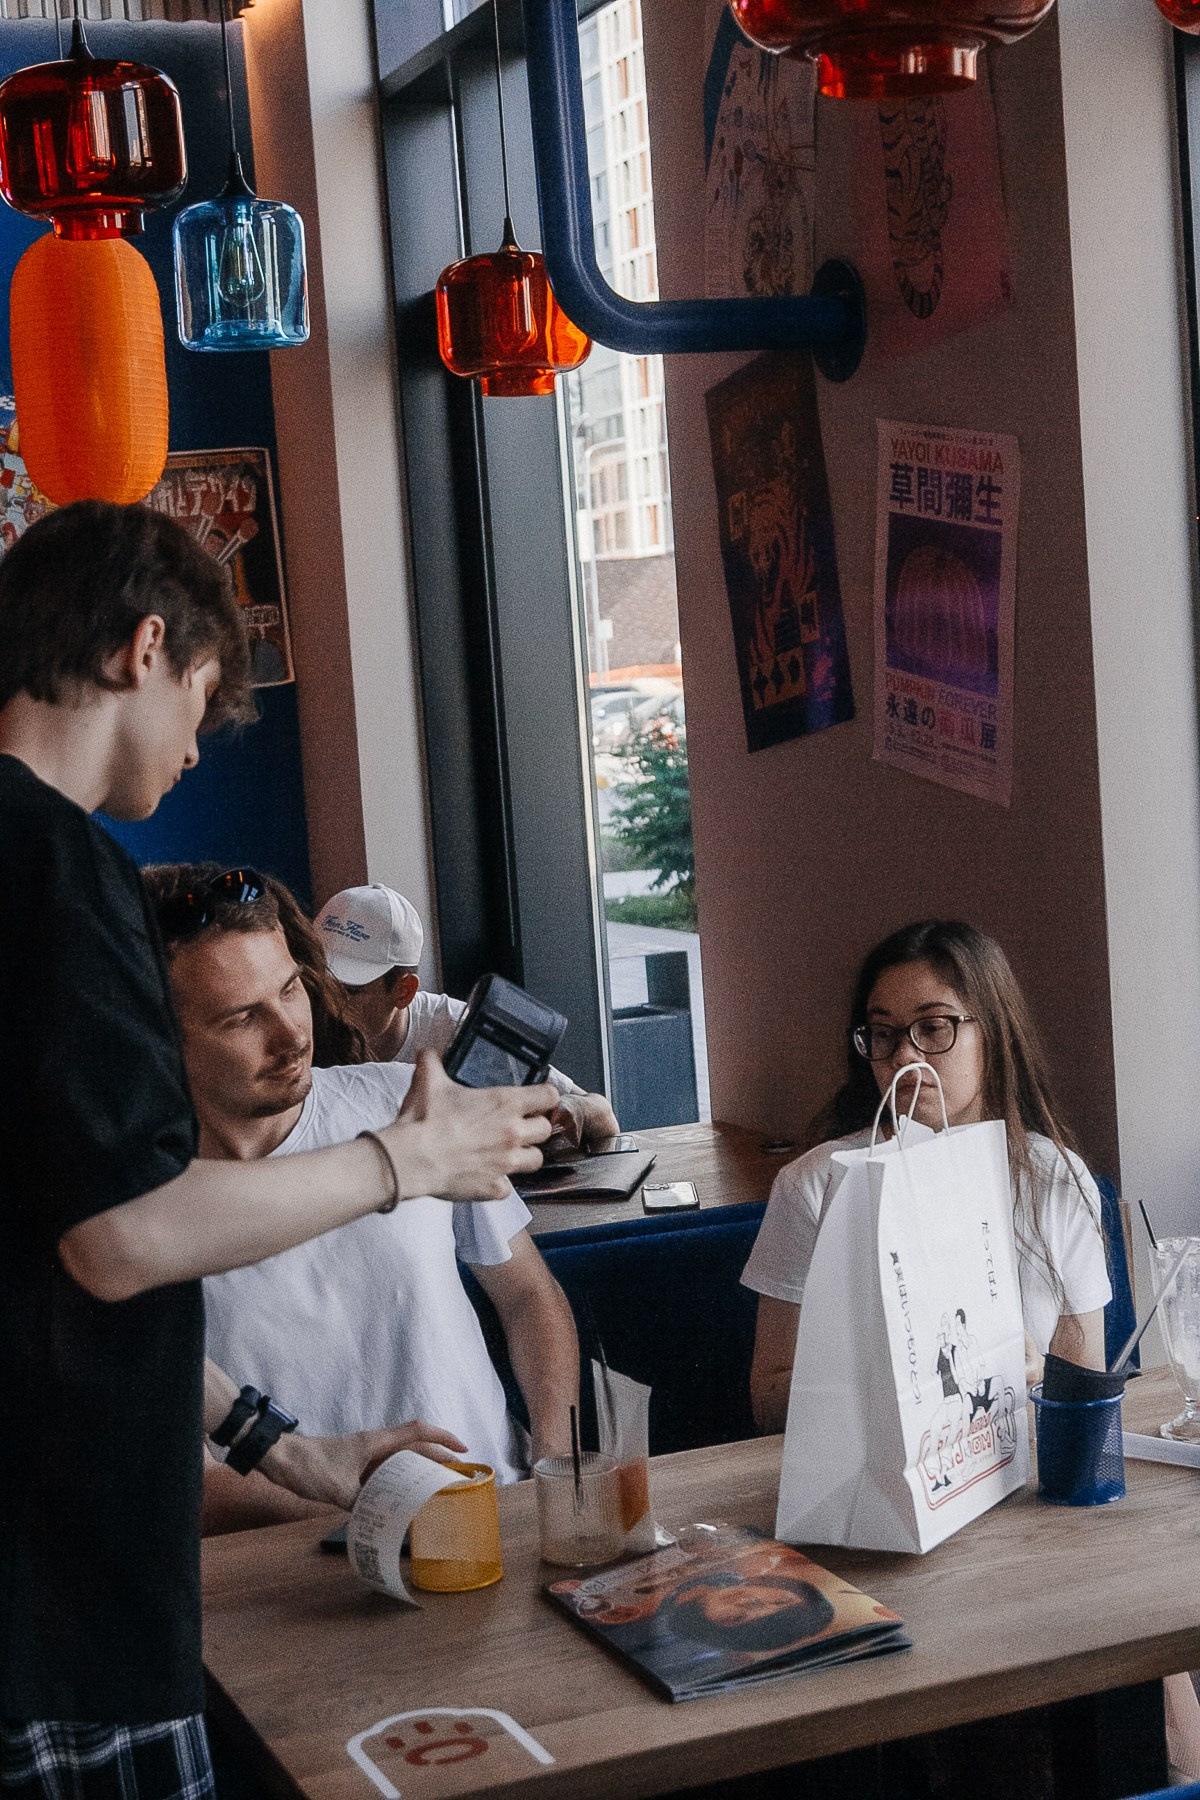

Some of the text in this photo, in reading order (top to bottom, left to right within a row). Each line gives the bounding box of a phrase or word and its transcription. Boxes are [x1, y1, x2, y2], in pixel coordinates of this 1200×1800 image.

[890, 438, 1004, 474] YAYOI KUSAMA
[889, 462, 1003, 526] 草間彌生
[938, 690, 997, 720] FOREVER
